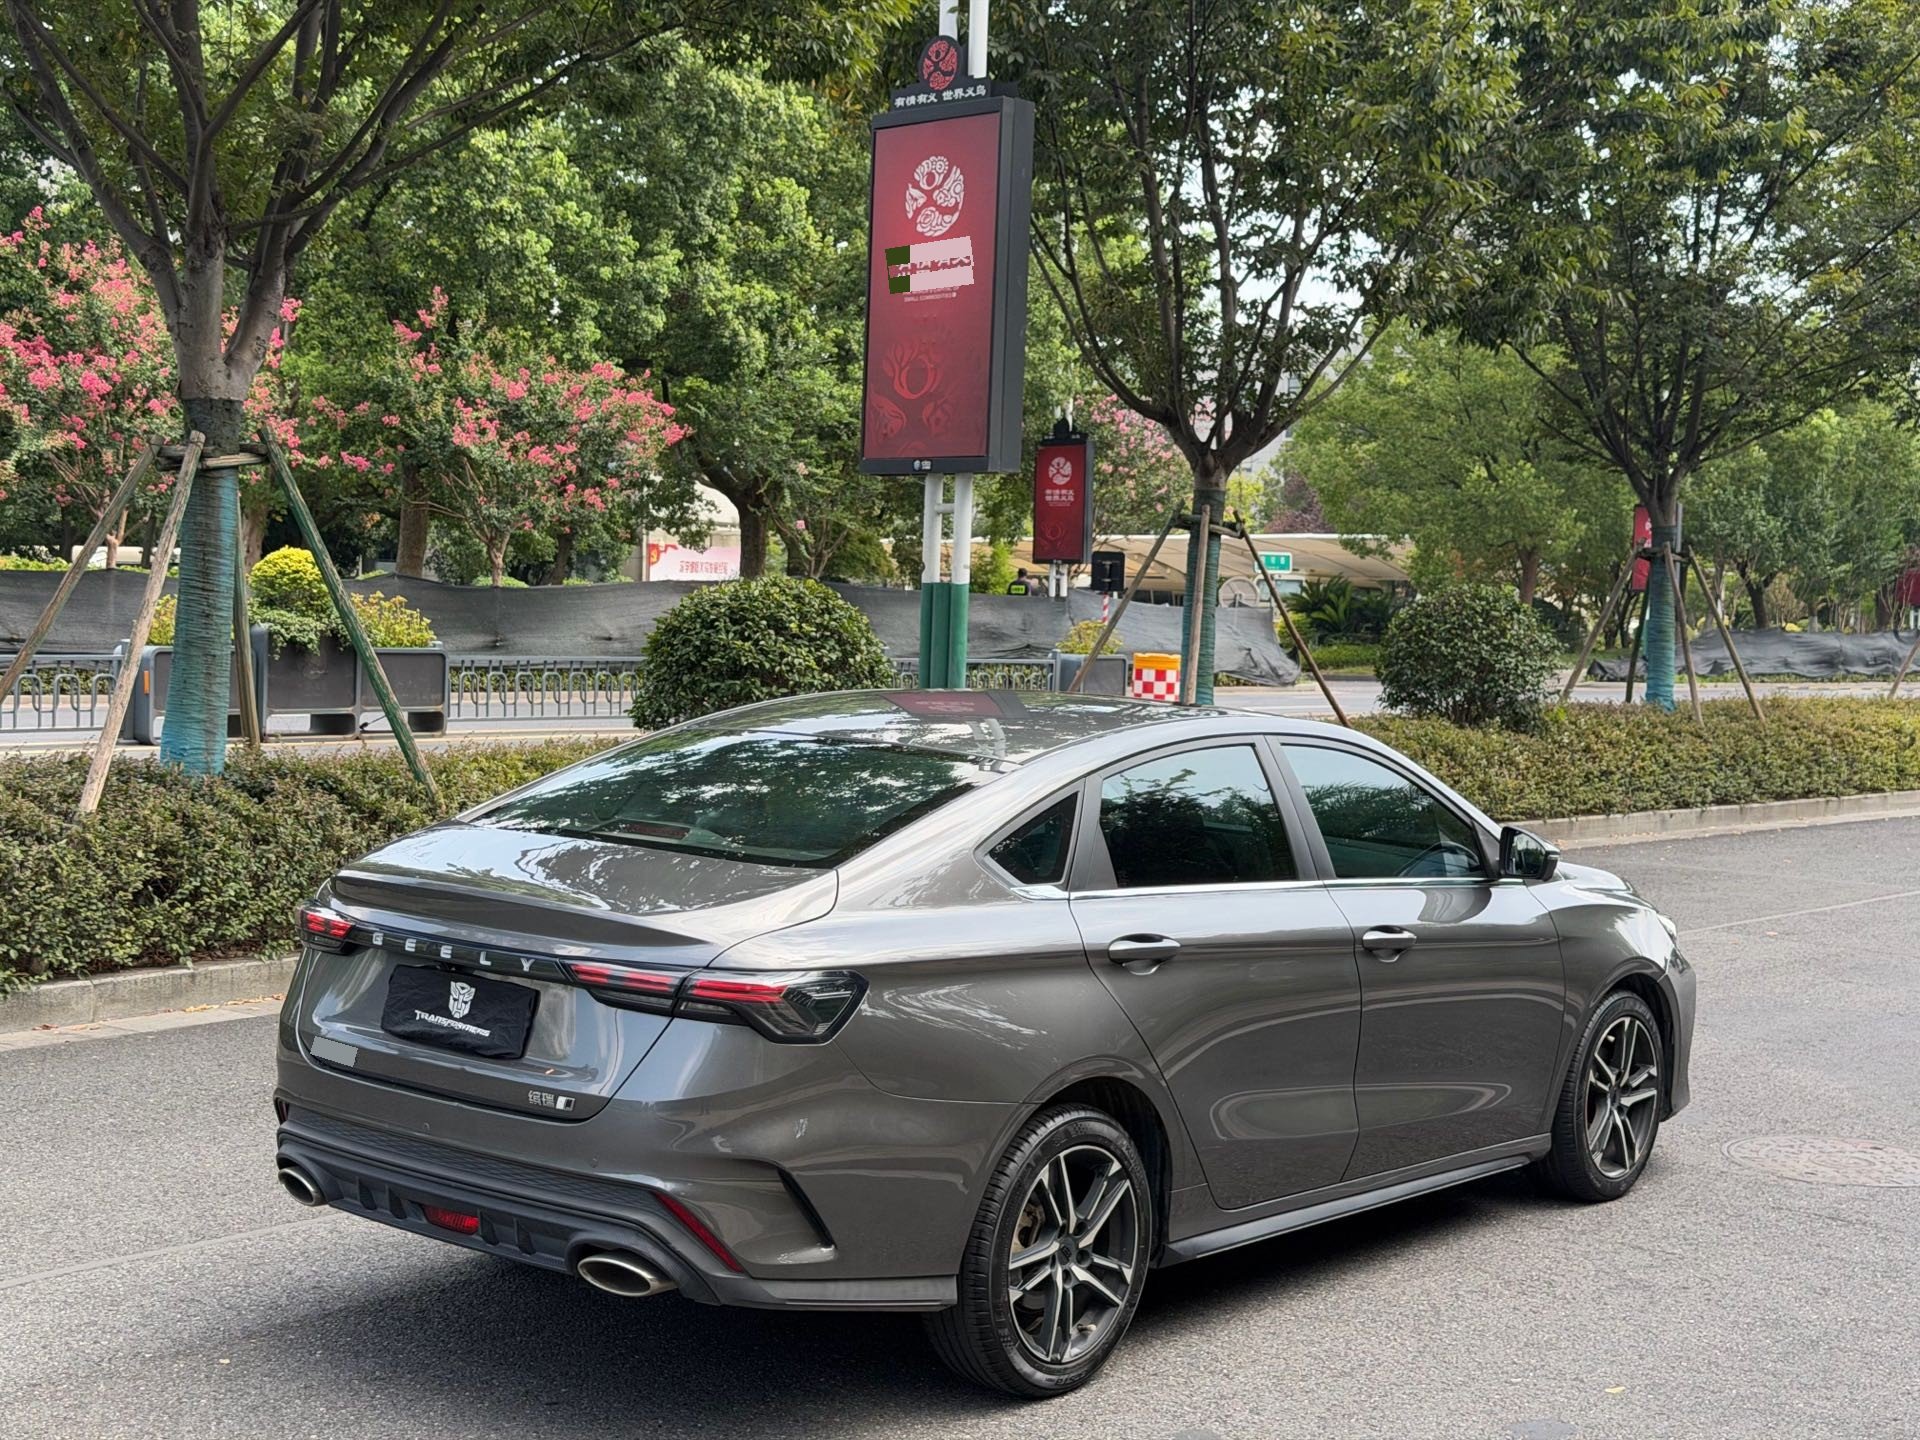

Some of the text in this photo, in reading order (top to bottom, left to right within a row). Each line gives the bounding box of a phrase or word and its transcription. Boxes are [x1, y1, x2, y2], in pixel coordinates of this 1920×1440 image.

[942, 84, 986, 101] 世界义乌
[372, 932, 535, 972] GEELY
[414, 1009, 491, 1037] TRANSFORMERS
